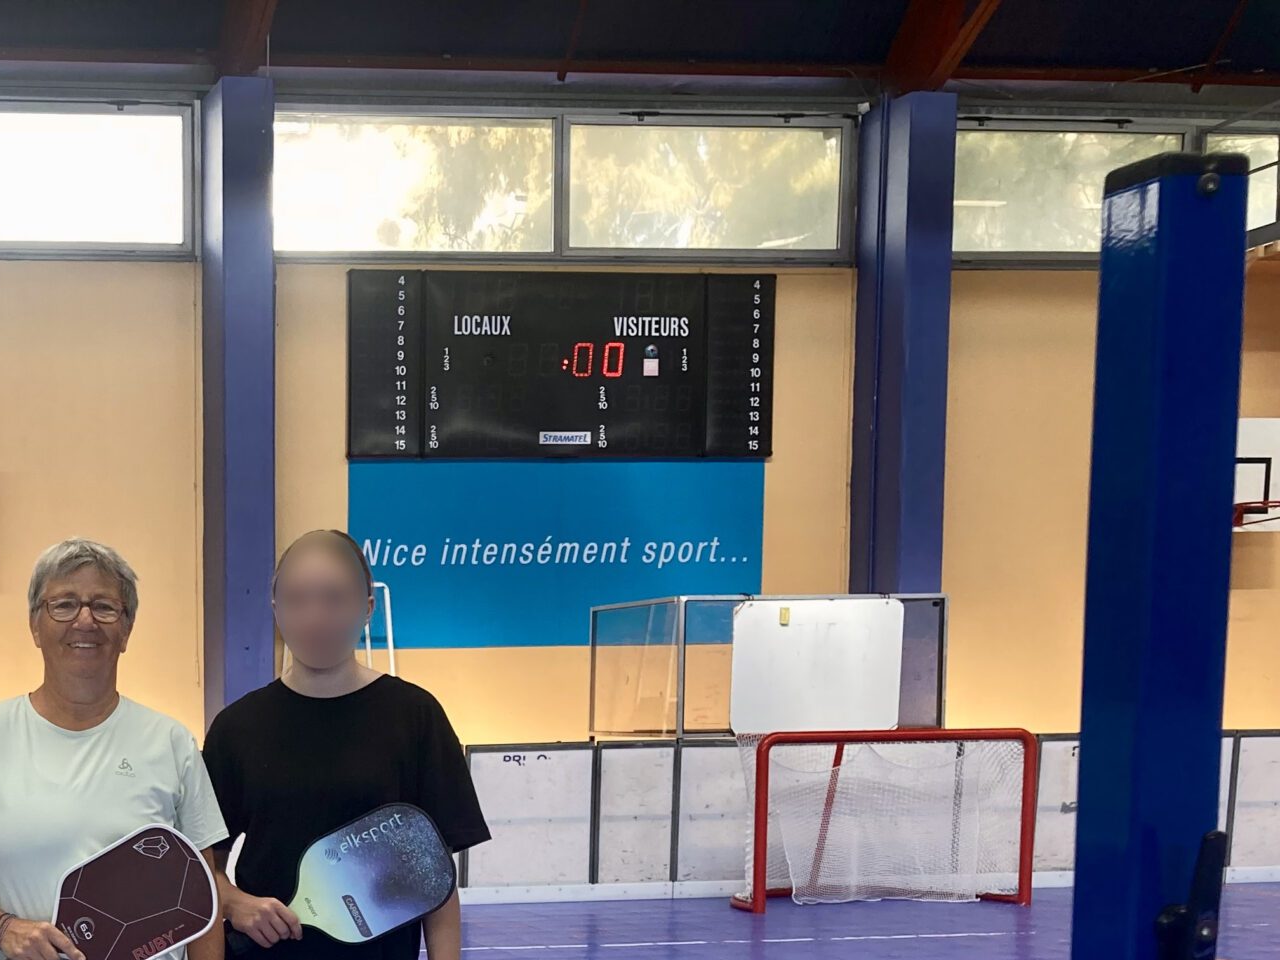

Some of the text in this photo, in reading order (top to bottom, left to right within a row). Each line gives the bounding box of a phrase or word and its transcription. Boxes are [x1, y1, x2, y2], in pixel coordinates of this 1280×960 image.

[398, 276, 405, 285] 4
[754, 280, 760, 289] 4
[398, 291, 405, 300] 5
[754, 295, 760, 304] 5
[398, 306, 405, 315] 6
[754, 309, 760, 319] 6
[398, 321, 405, 330] 7
[454, 315, 511, 336] LOCAUX
[613, 316, 689, 337] VISITEURS
[754, 324, 760, 333] 7
[398, 336, 405, 345] 8
[753, 339, 760, 348] 8
[398, 351, 405, 360] 9
[753, 353, 760, 363] 9
[395, 366, 406, 375] 10
[750, 368, 761, 377] 10
[396, 381, 406, 390] 11
[750, 383, 760, 392] 11
[396, 396, 406, 405] 12
[750, 397, 760, 406] 12
[395, 411, 406, 420] 13
[749, 411, 760, 421] 13
[395, 425, 405, 435] 14
[748, 426, 759, 435] 14
[542, 433, 588, 443] STRAMATEL
[395, 440, 405, 449] 15
[748, 441, 759, 450] 15
[362, 536, 749, 568] Nice intensément sport...
[339, 812, 404, 854] elksport
[345, 897, 364, 927] CARBON
